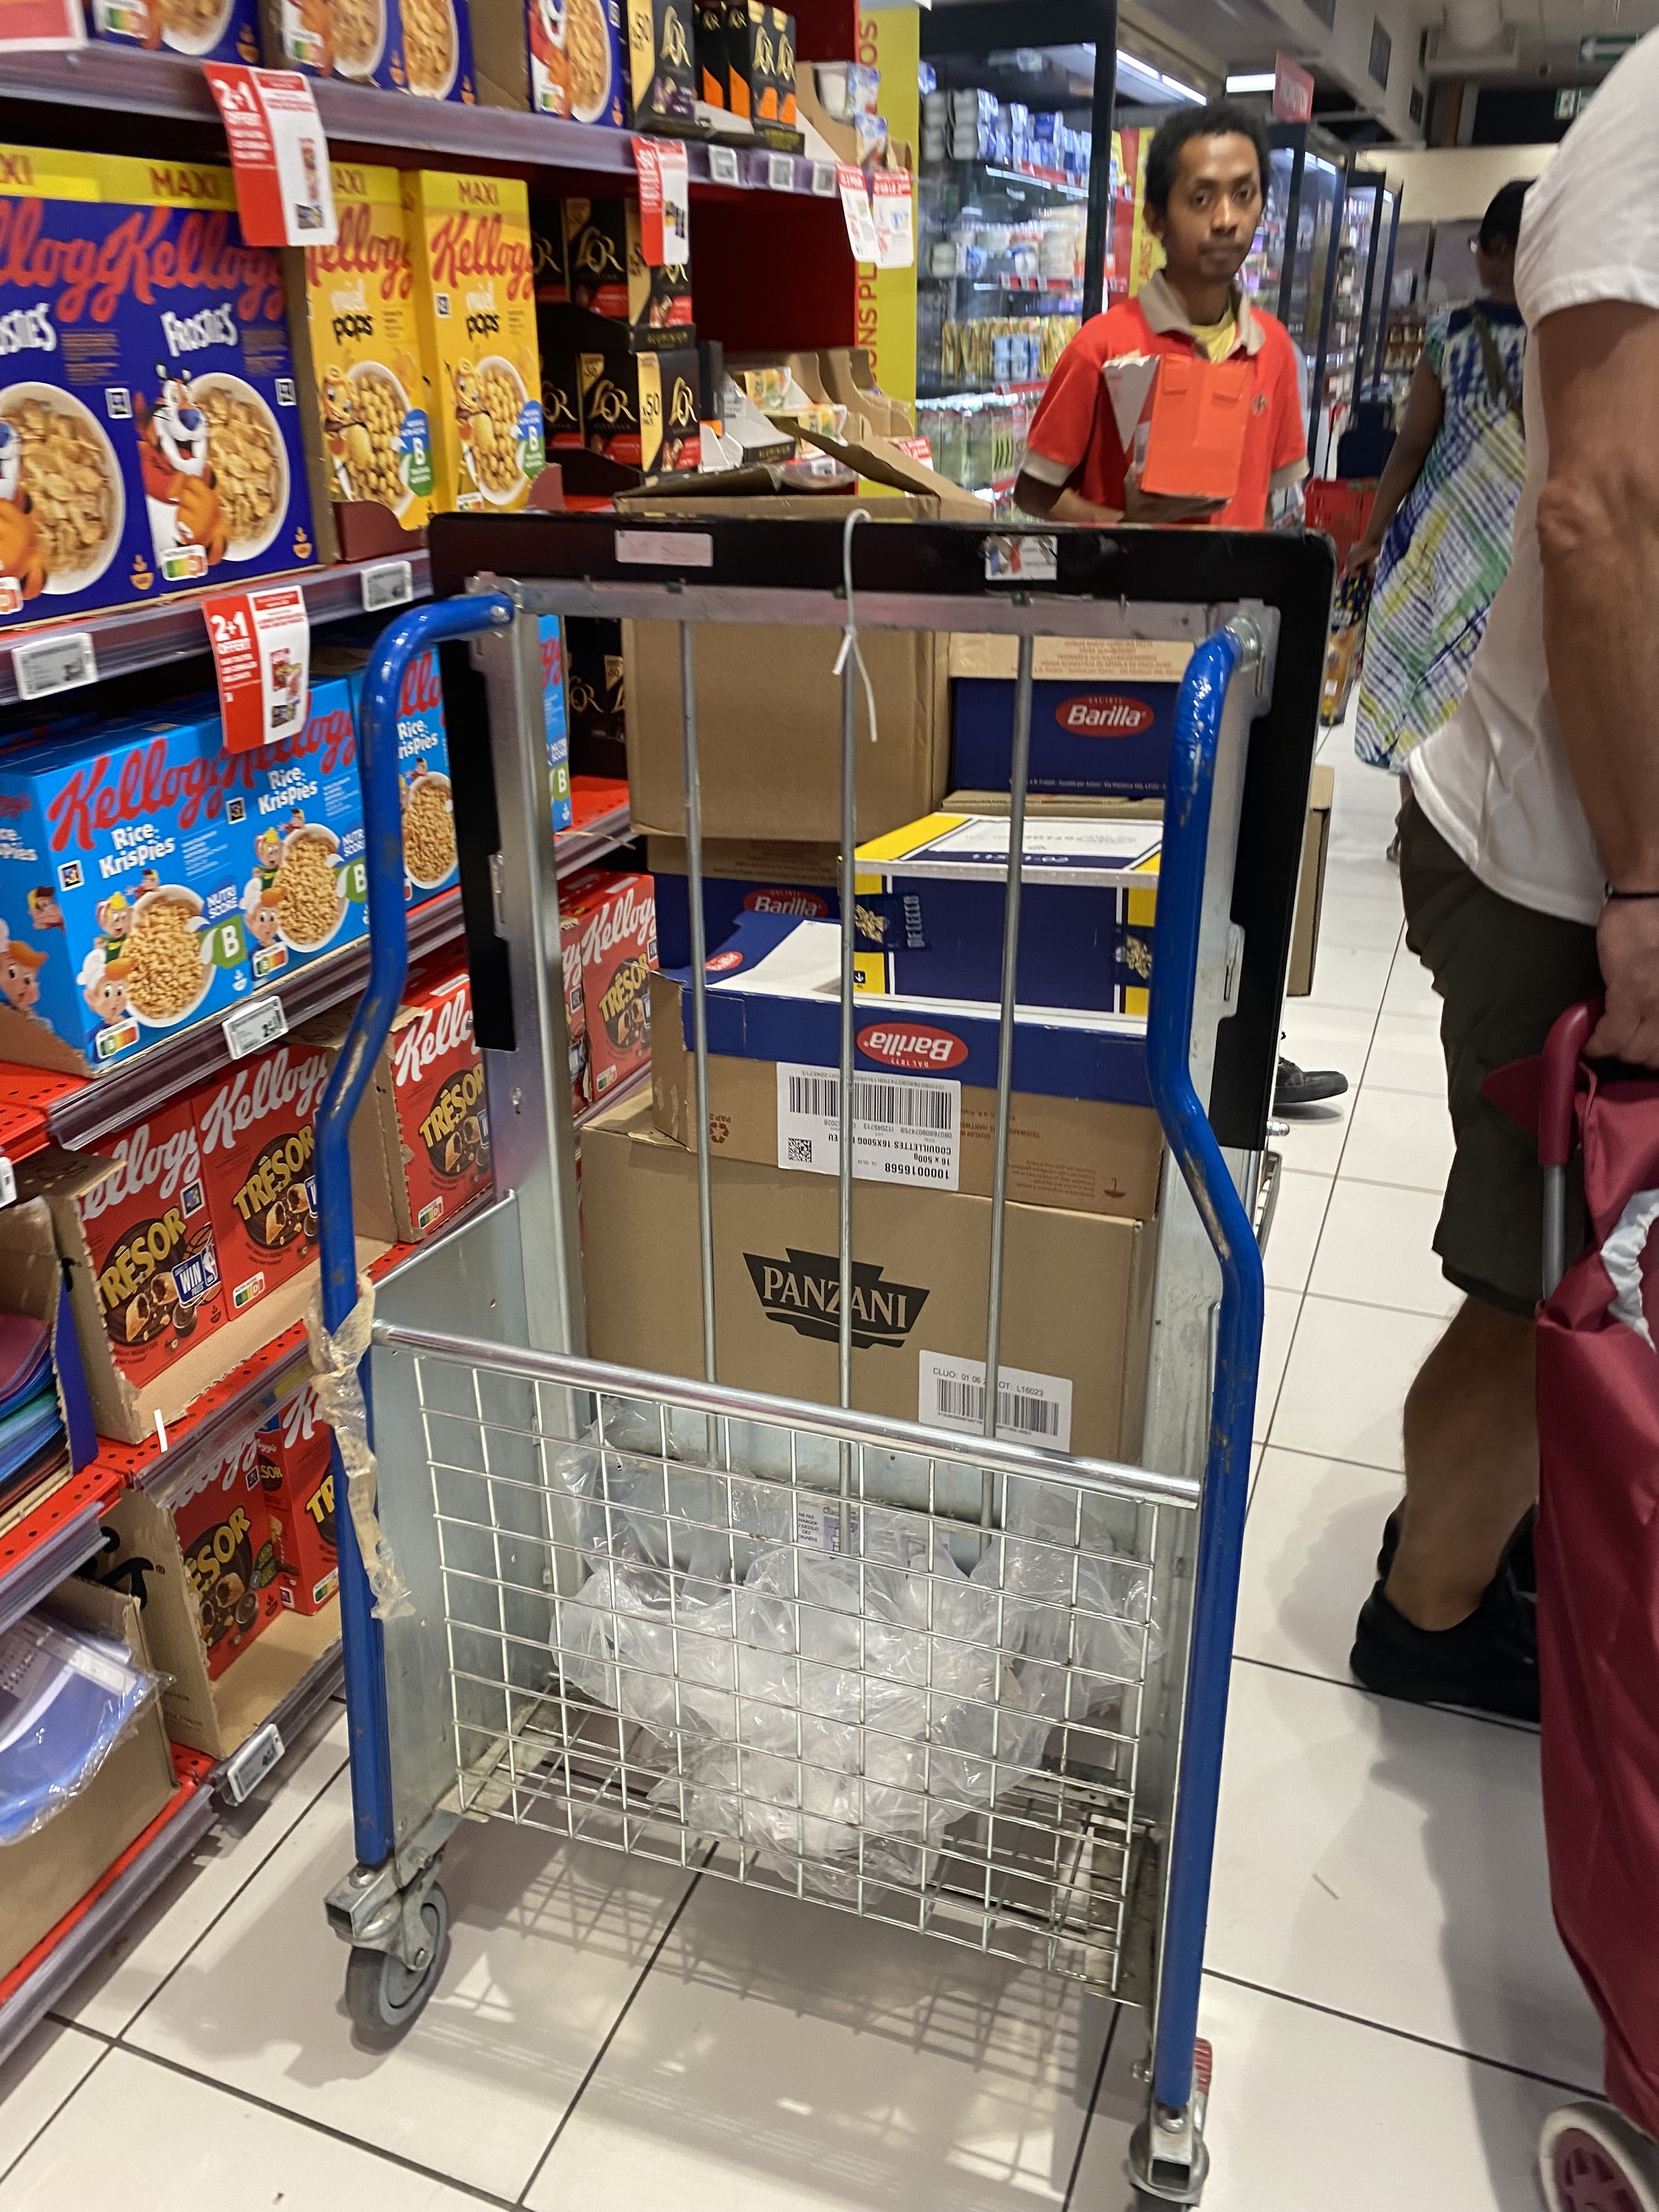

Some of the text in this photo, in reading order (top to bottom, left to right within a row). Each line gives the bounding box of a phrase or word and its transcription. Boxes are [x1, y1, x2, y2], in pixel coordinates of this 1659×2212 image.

[332, 168, 367, 196] AXI
[457, 179, 500, 207] MAXI
[210, 611, 249, 642] 2+1
[1068, 704, 1141, 727] Barilla
[398, 732, 438, 760] rispies
[268, 767, 302, 790] Rice
[558, 768, 567, 793] B
[258, 780, 318, 815] Krispies
[111, 823, 155, 850] Rice
[99, 837, 176, 879] Krispies
[353, 863, 367, 894] B
[754, 895, 819, 917] Barilla
[221, 925, 240, 958] B
[868, 1031, 955, 1062] Barilla
[715, 1114, 731, 1123] PAP
[828, 1133, 952, 1155] COQUILLETTES 16X500G EU
[1009, 1127, 1040, 1139] TEIGWARE
[81, 1122, 200, 1221] ellogg
[233, 1125, 314, 1221] TRÉSOR
[884, 1162, 950, 1180] 1000016568
[98, 1206, 187, 1316] RÉSOR
[179, 1261, 202, 1295] WIN
[763, 1265, 907, 1329] PANZANI
[997, 1382, 1013, 1390] OT:
[261, 1465, 283, 1479] SOR
[798, 1517, 817, 1526] HARGER
